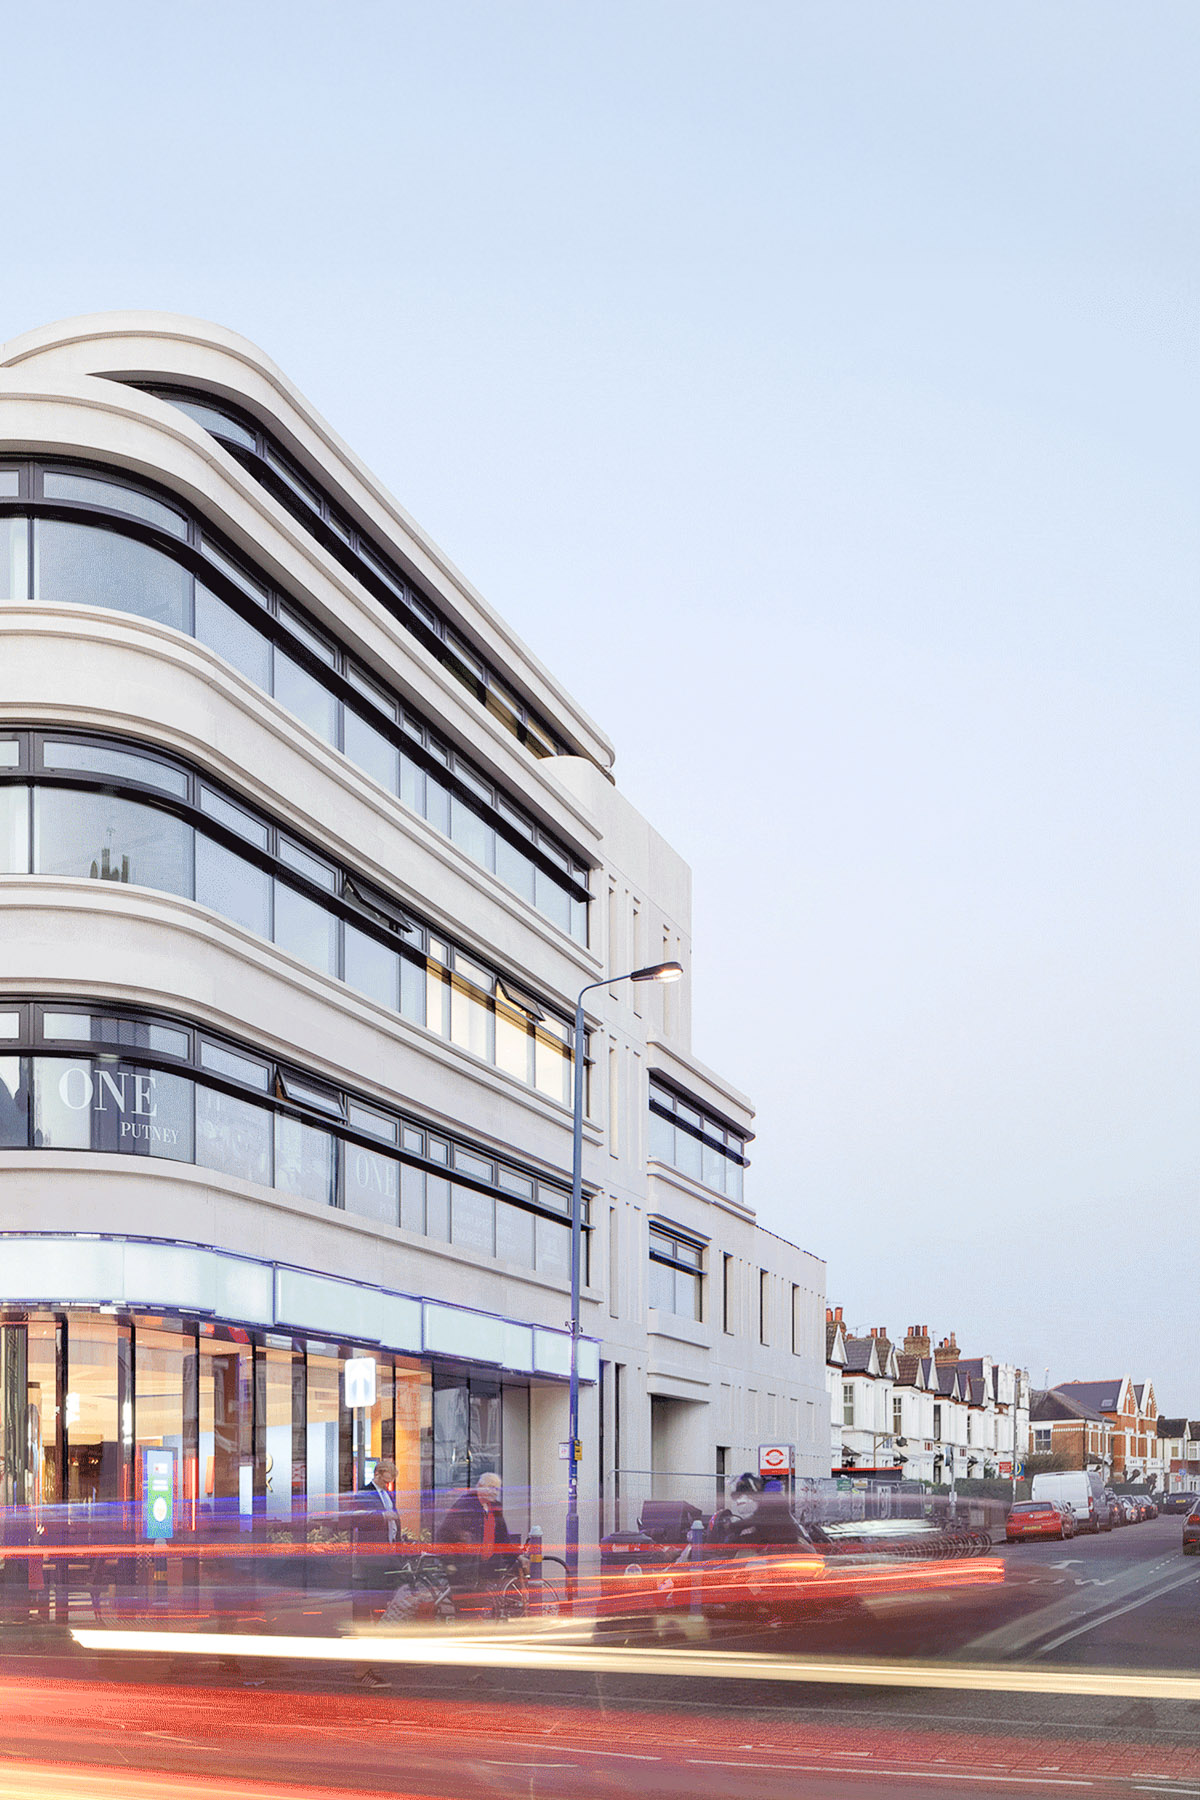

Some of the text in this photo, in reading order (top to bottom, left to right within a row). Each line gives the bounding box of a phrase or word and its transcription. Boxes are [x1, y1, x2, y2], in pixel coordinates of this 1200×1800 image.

[58, 1067, 158, 1117] ONE
[121, 1121, 179, 1145] PUTNEY
[356, 1152, 396, 1198] ONE
